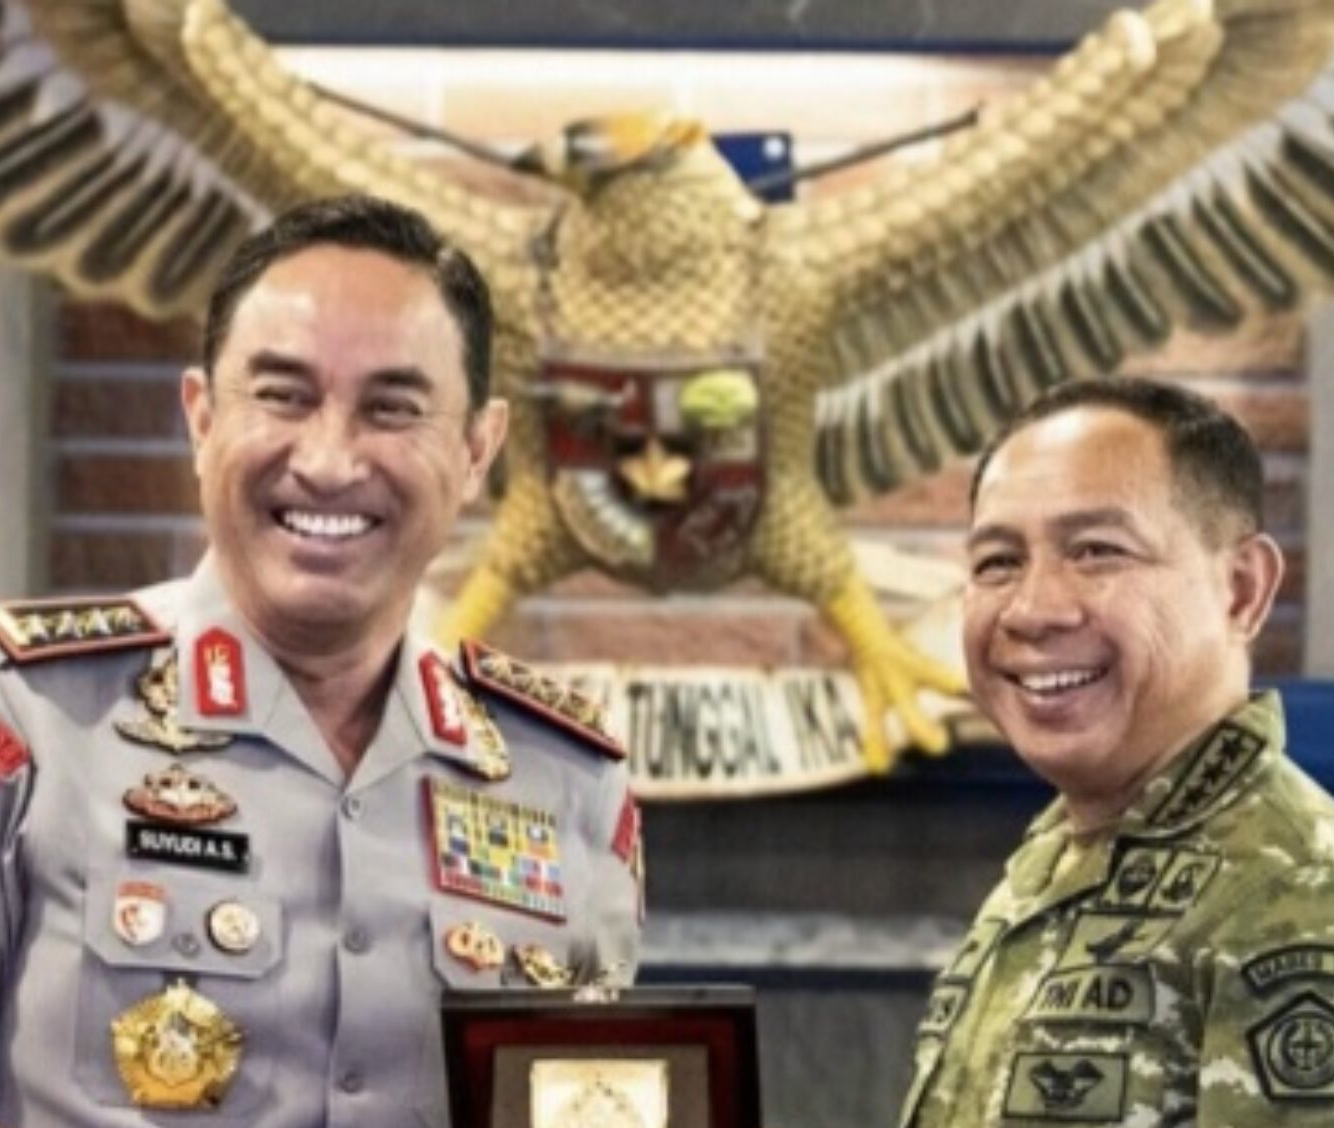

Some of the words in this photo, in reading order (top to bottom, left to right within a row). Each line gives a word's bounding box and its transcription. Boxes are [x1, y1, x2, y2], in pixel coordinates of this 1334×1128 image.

[627, 681, 780, 777] TUNGGAL
[784, 674, 864, 770] IKA
[138, 829, 202, 856] SUYUDI
[1082, 974, 1133, 1012] AD
